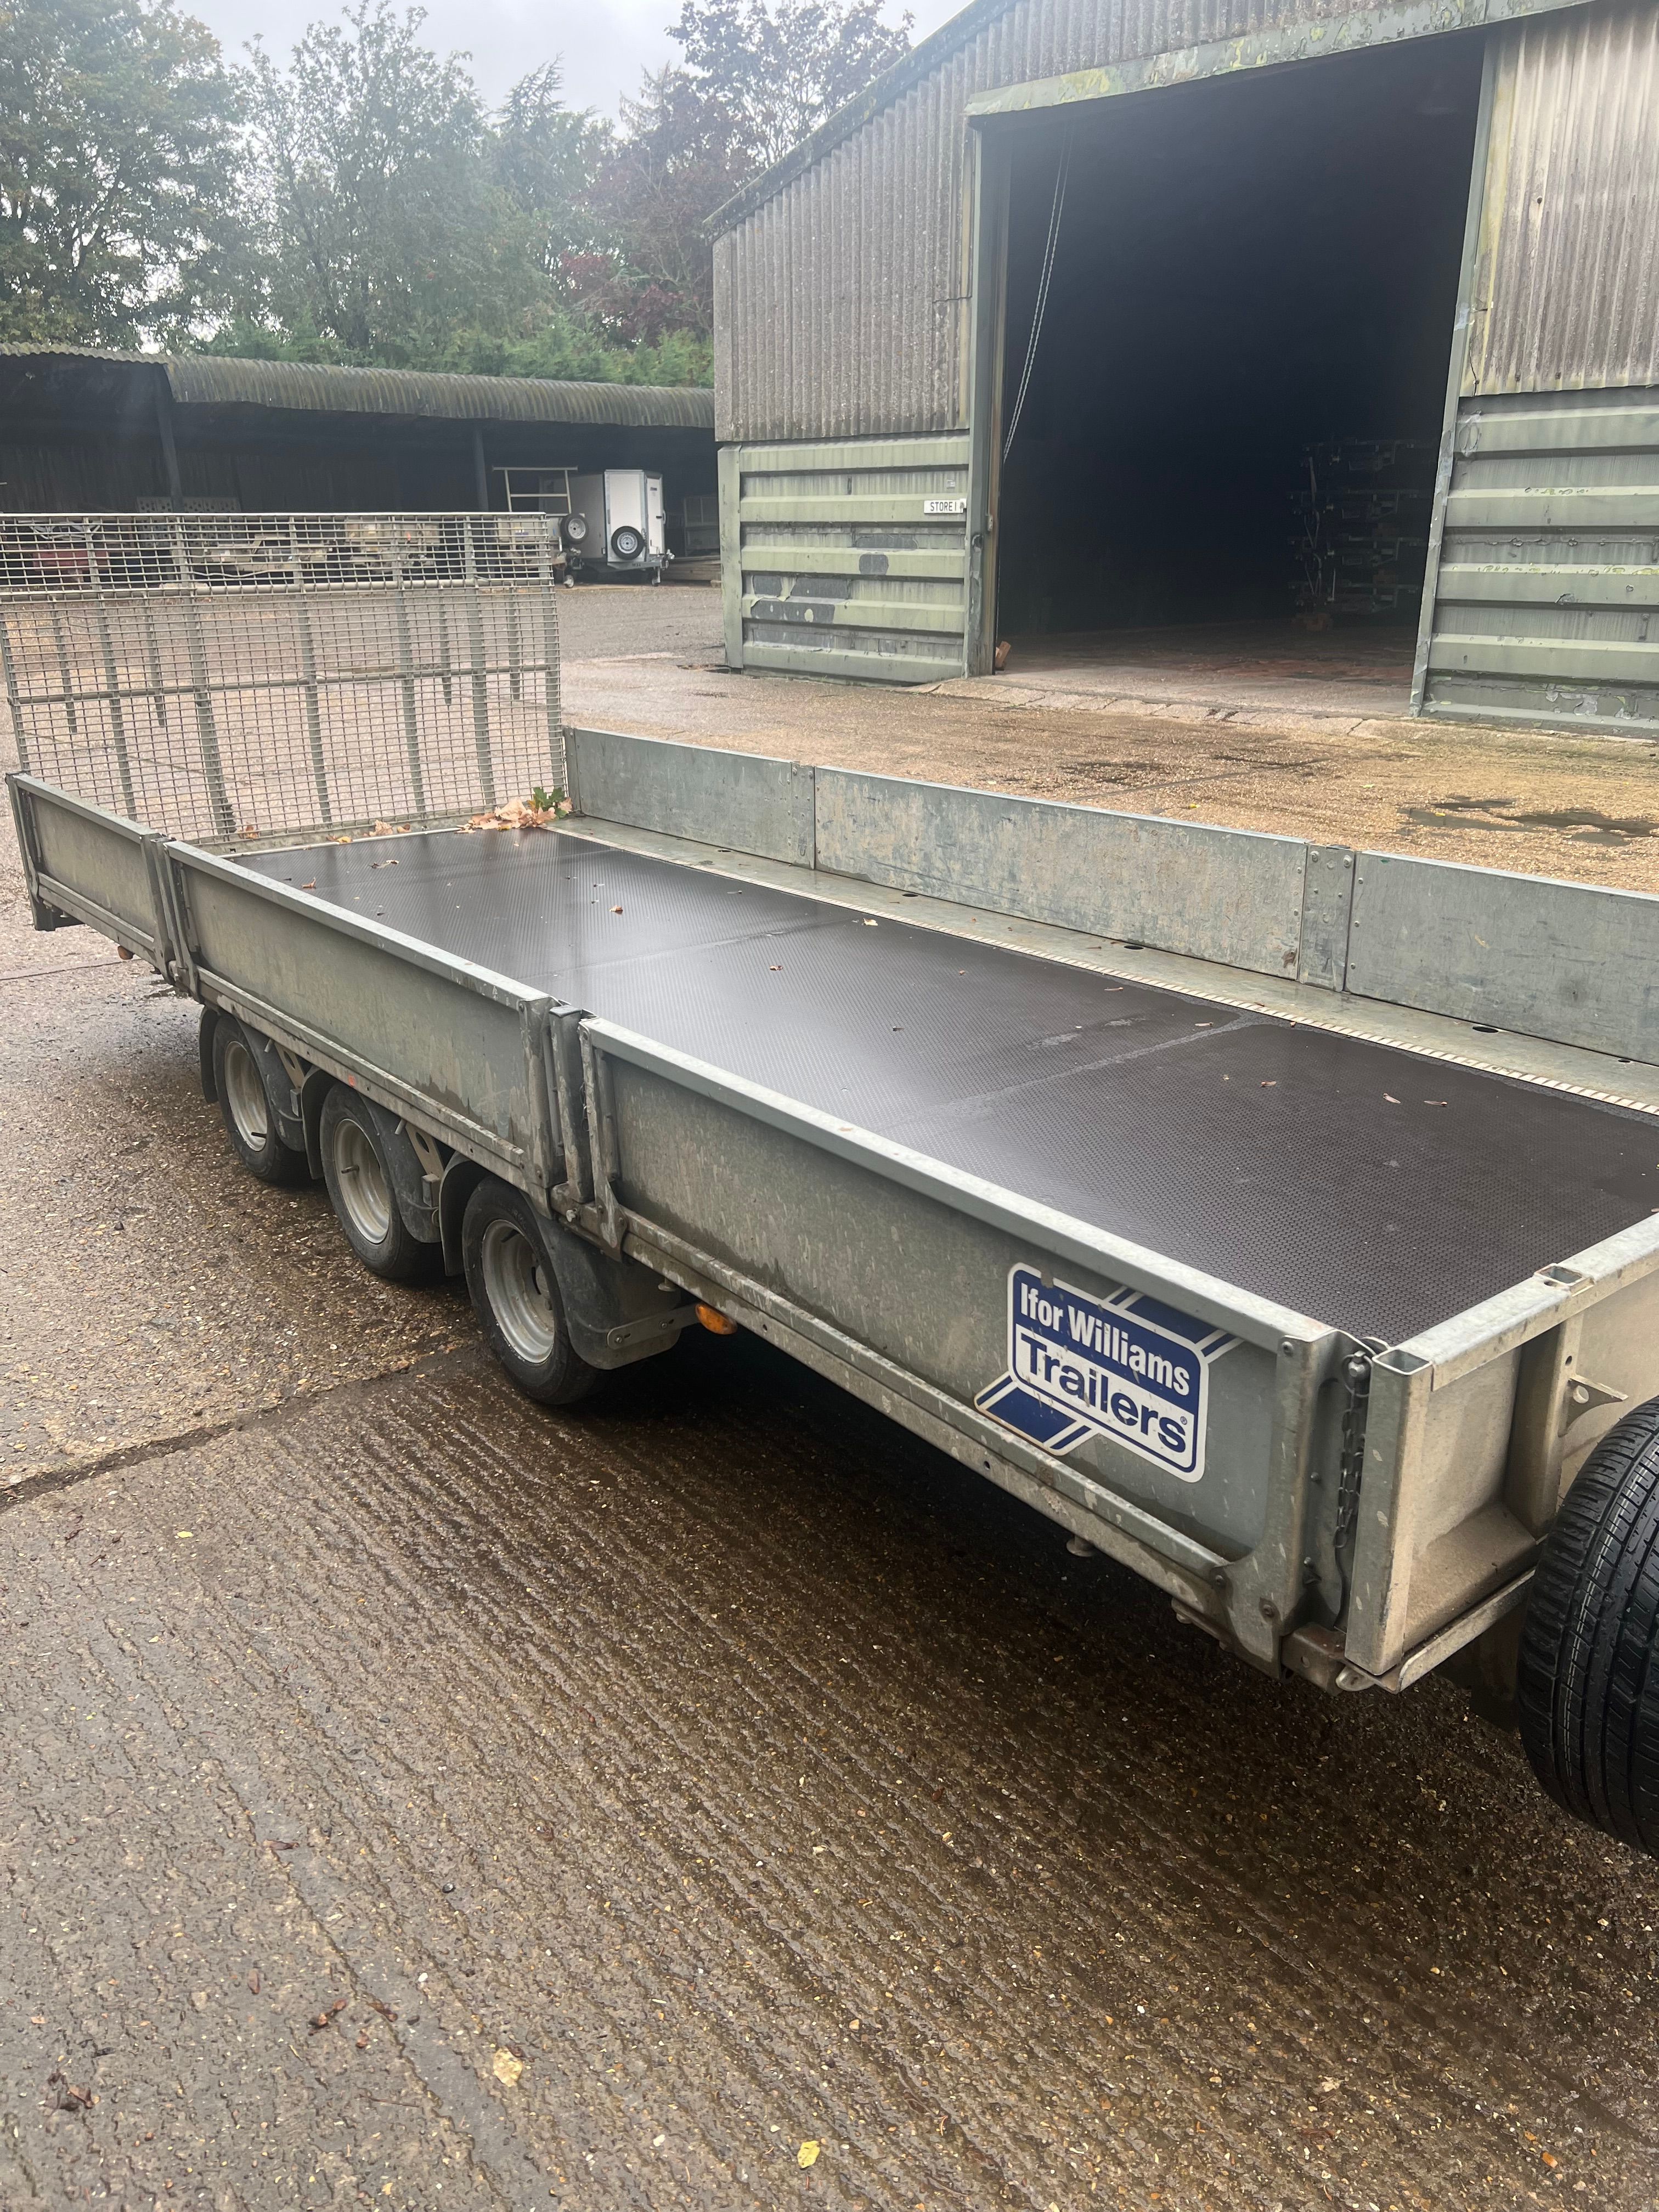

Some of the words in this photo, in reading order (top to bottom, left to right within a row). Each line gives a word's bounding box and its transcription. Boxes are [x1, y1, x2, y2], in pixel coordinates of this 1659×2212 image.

[930, 501, 953, 511] STORE
[1020, 1282, 1063, 1331] Ifor
[1067, 1305, 1190, 1396] Williams
[1020, 1333, 1186, 1453] Trailers
